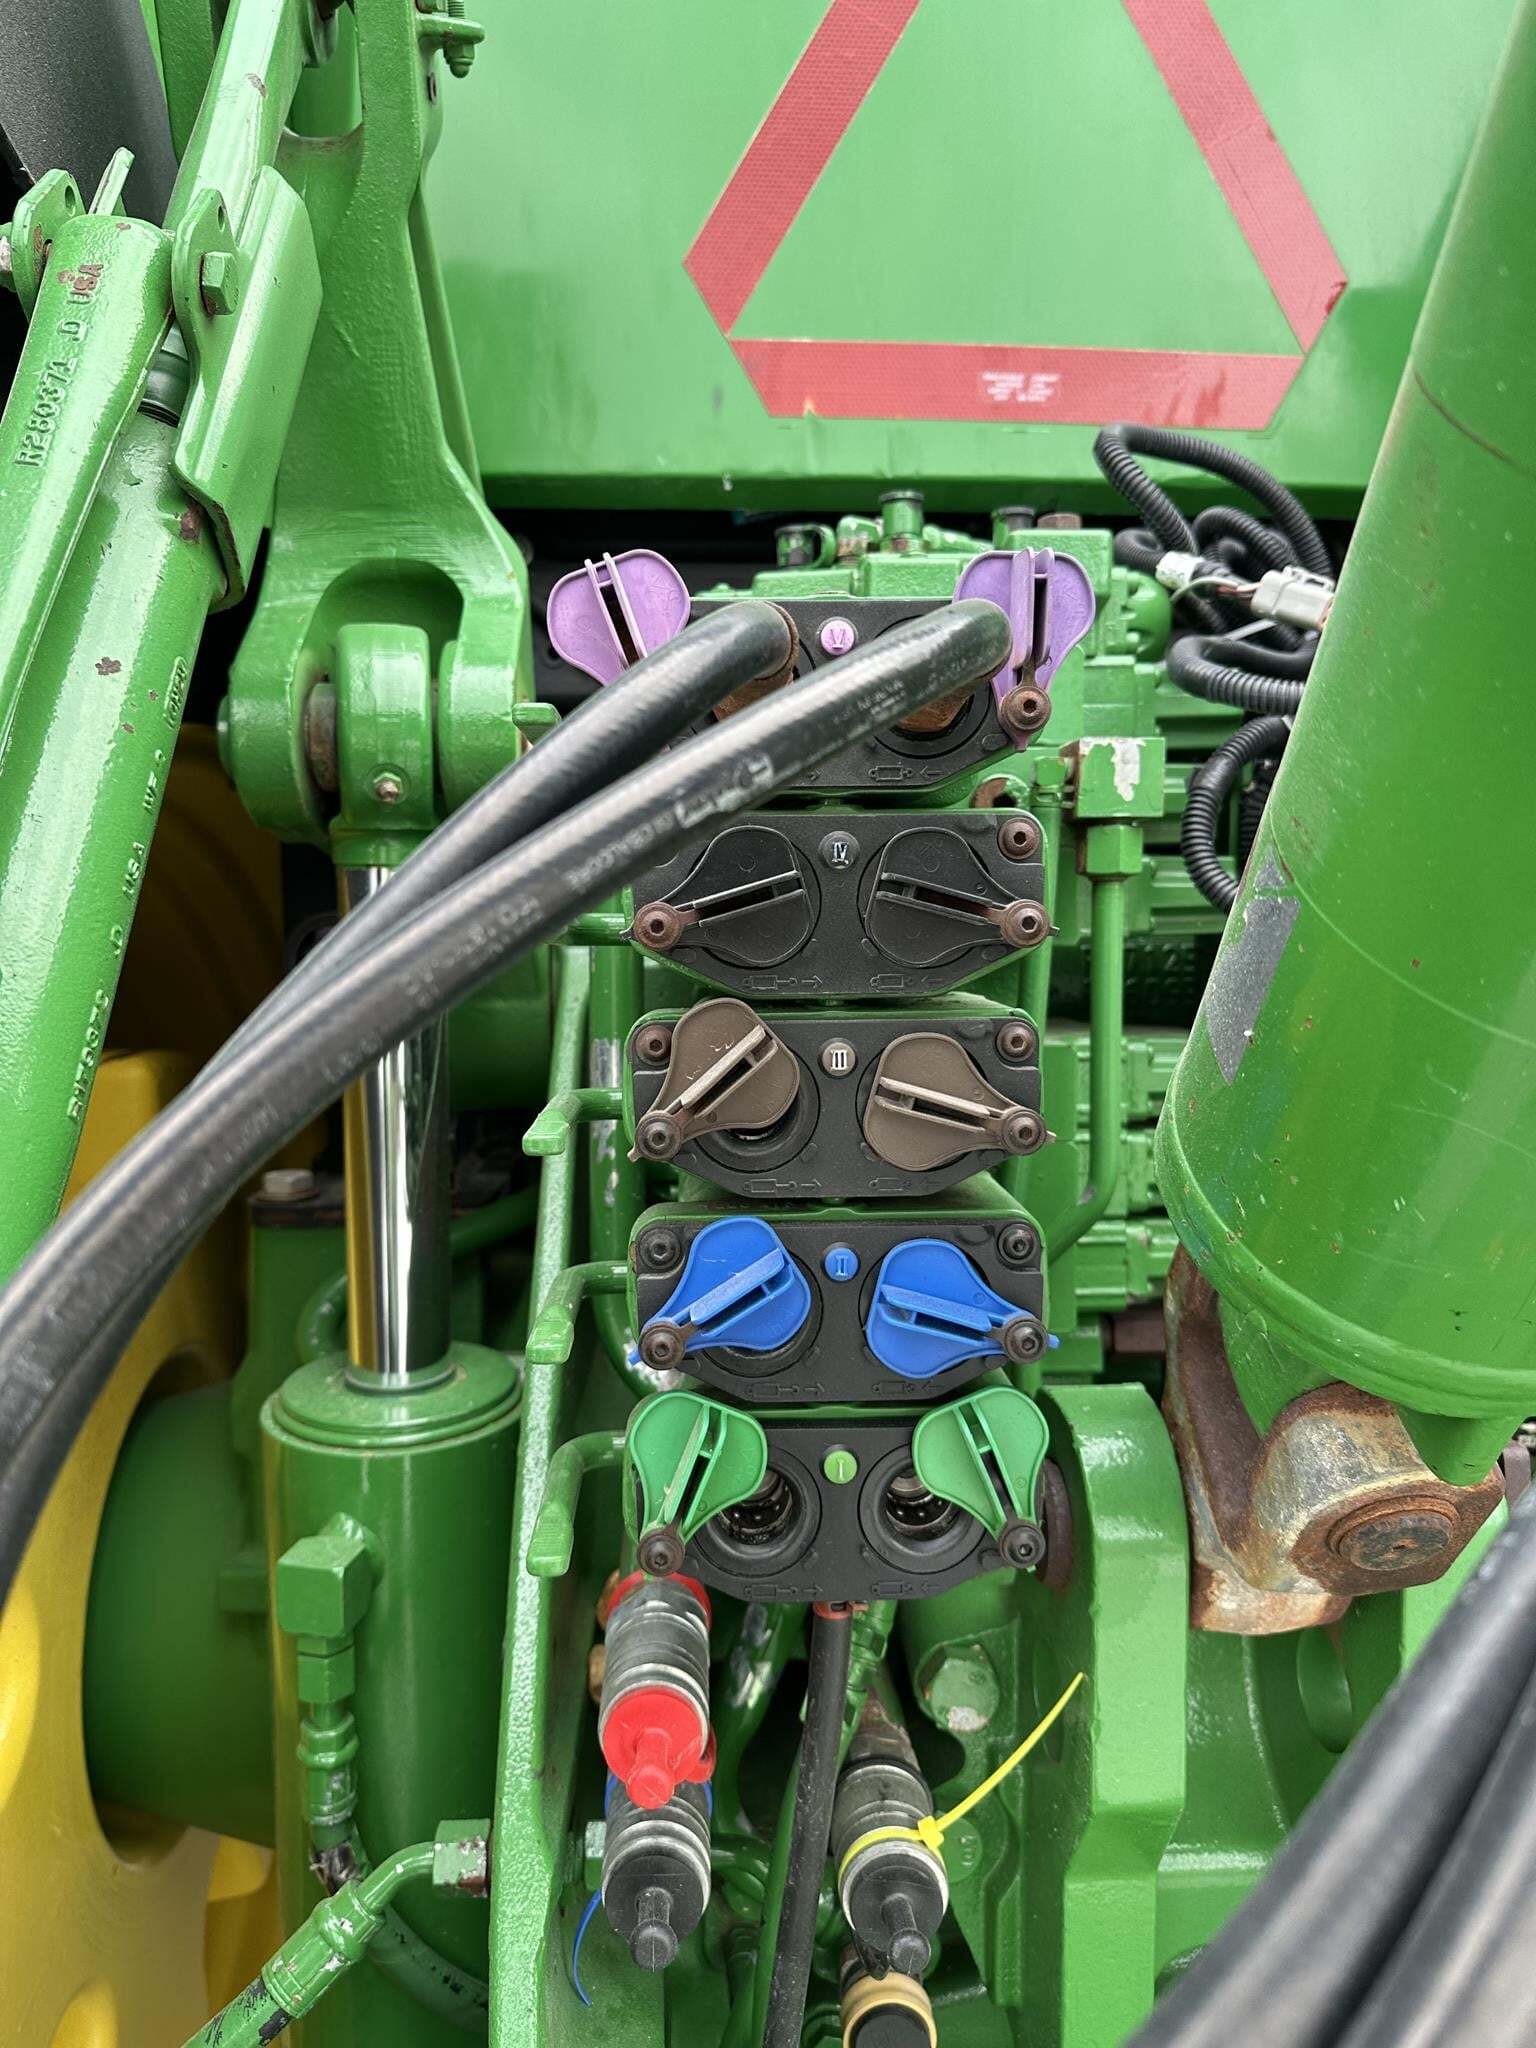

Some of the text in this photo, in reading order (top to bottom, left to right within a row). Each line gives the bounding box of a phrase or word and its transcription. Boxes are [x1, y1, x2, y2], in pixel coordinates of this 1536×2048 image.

[66, 263, 105, 305] USA
[831, 841, 849, 864] IV
[830, 1049, 848, 1070] III
[834, 1254, 849, 1276] II
